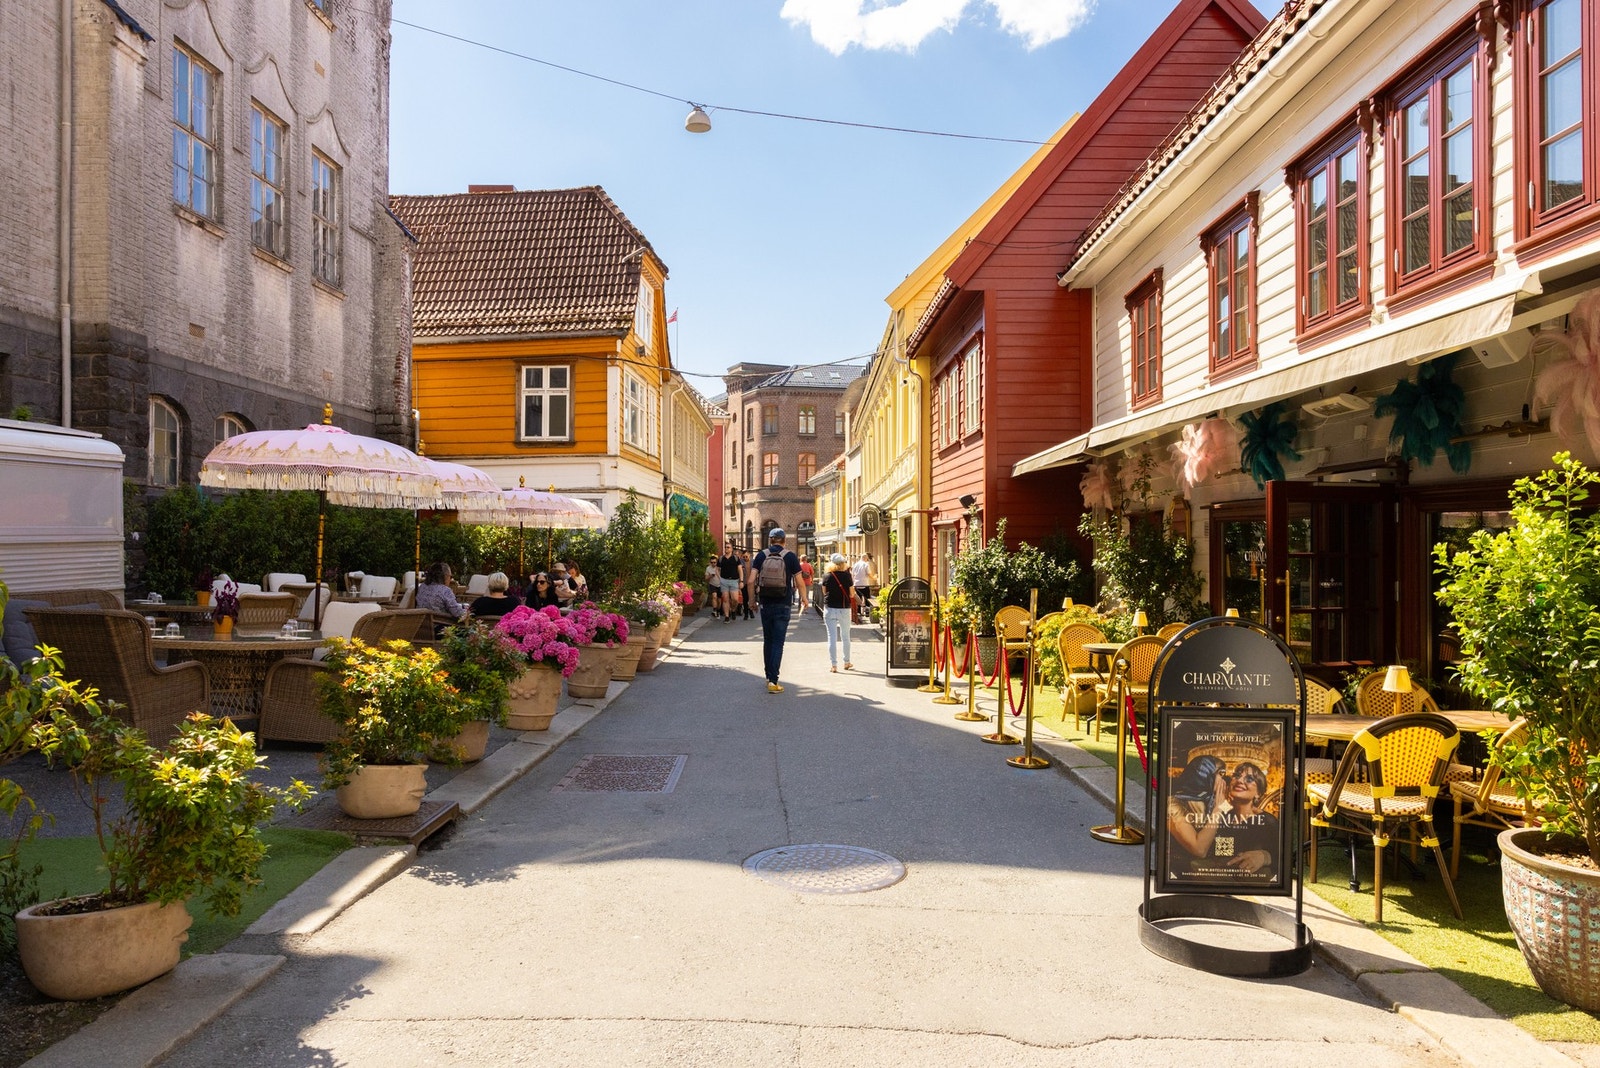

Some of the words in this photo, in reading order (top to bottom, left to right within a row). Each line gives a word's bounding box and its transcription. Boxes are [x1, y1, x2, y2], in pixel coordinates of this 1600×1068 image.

[1182, 672, 1271, 688] CHARMANTE
[1196, 734, 1234, 742] BOUTIQUE
[1236, 735, 1261, 743] HOTEL
[1185, 812, 1265, 828] CHARMANTE
